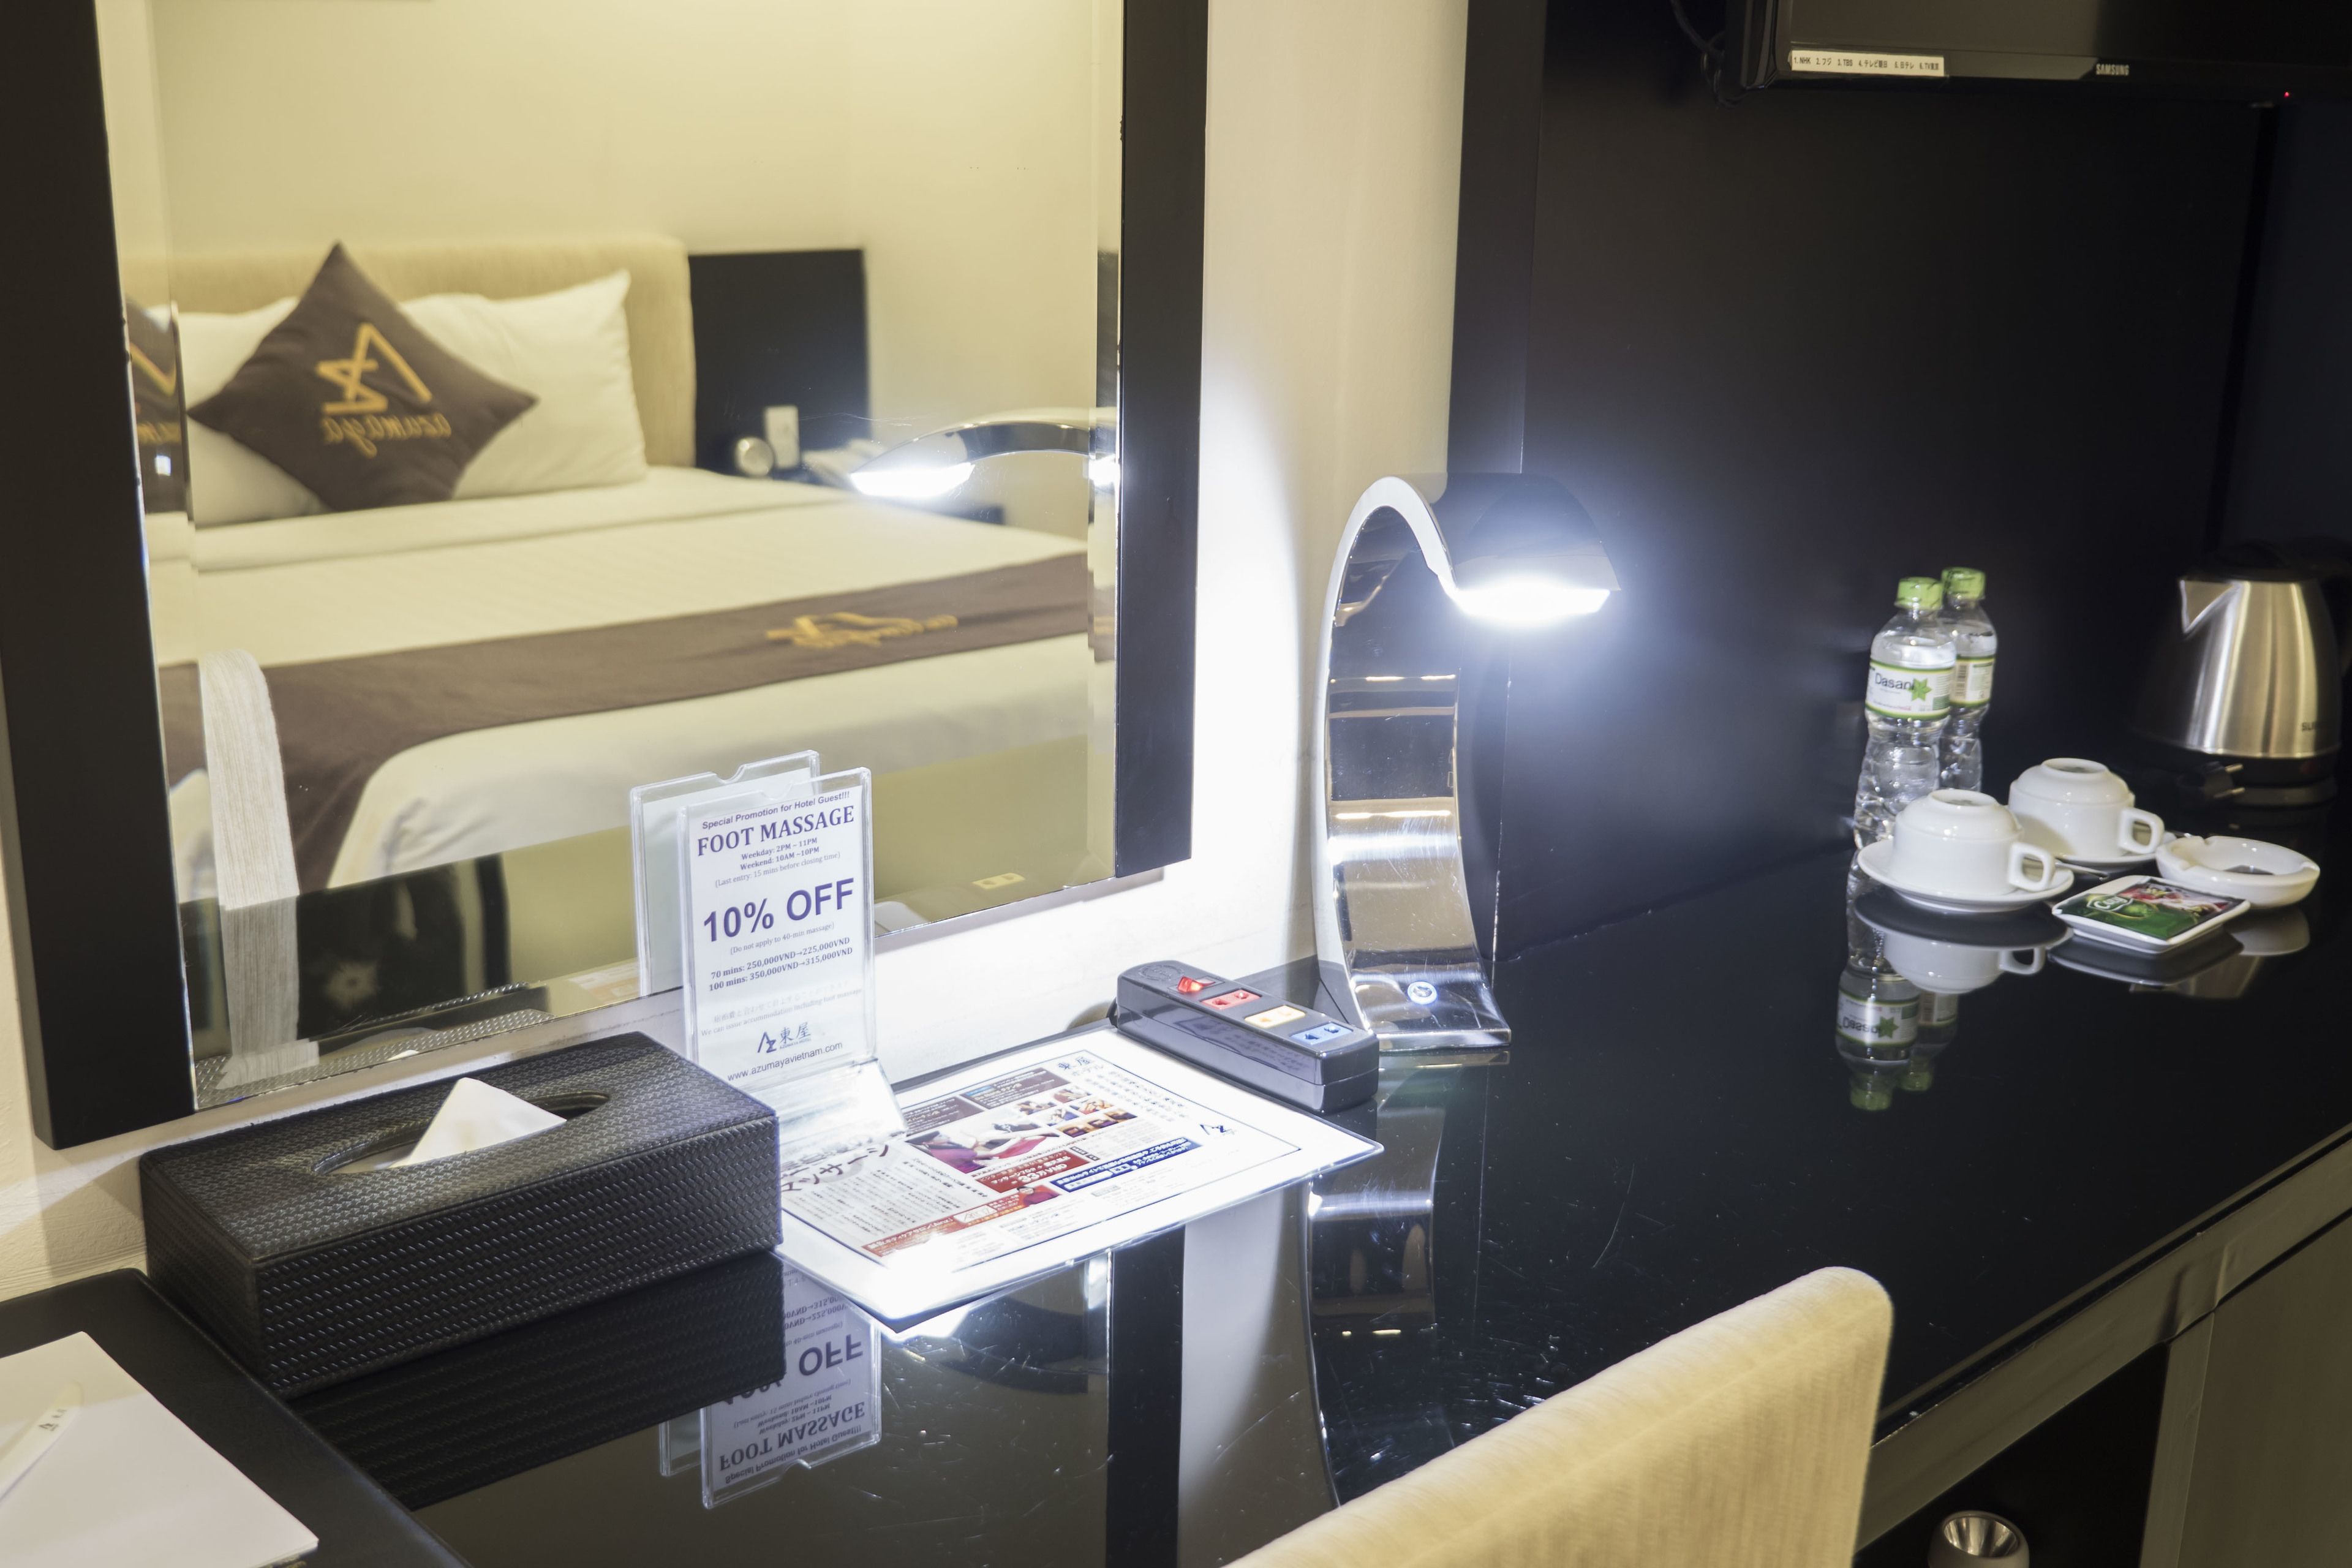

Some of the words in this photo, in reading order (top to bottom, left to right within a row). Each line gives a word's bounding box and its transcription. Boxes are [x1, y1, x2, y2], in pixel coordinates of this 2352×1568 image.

[2095, 63, 2130, 75] SAMSUNG
[702, 816, 733, 830] Special
[735, 807, 778, 823] Promotion
[794, 798, 816, 810] Hotel
[818, 791, 850, 804] Guest!!!
[697, 827, 755, 856] FOOT
[760, 805, 854, 842] MASSAGE
[740, 858, 774, 870] Weekend:
[775, 852, 795, 863] 10AM
[741, 848, 775, 861] Weekday:
[776, 843, 791, 853] 2PM
[799, 837, 818, 847] 11PM
[715, 876, 732, 888] (Last
[733, 873, 752, 884] entry:
[763, 867, 778, 876] mins
[780, 861, 801, 871] before
[801, 856, 823, 867] closing
[824, 851, 841, 861] time)
[704, 897, 775, 942] 10%
[786, 877, 854, 921] OFF
[729, 946, 742, 956] (Do
[755, 937, 773, 949] apply
[782, 930, 805, 941] 40-min
[806, 922, 835, 935] massage)
[709, 981, 725, 992] 100
[726, 975, 748, 987] mins:
[710, 970, 722, 979] 70
[723, 965, 745, 976] mins:
[701, 1028, 712, 1037] We
[780, 1022, 812, 1044] 東屋
[727, 1042, 843, 1082] www.azumayavietnam.com
